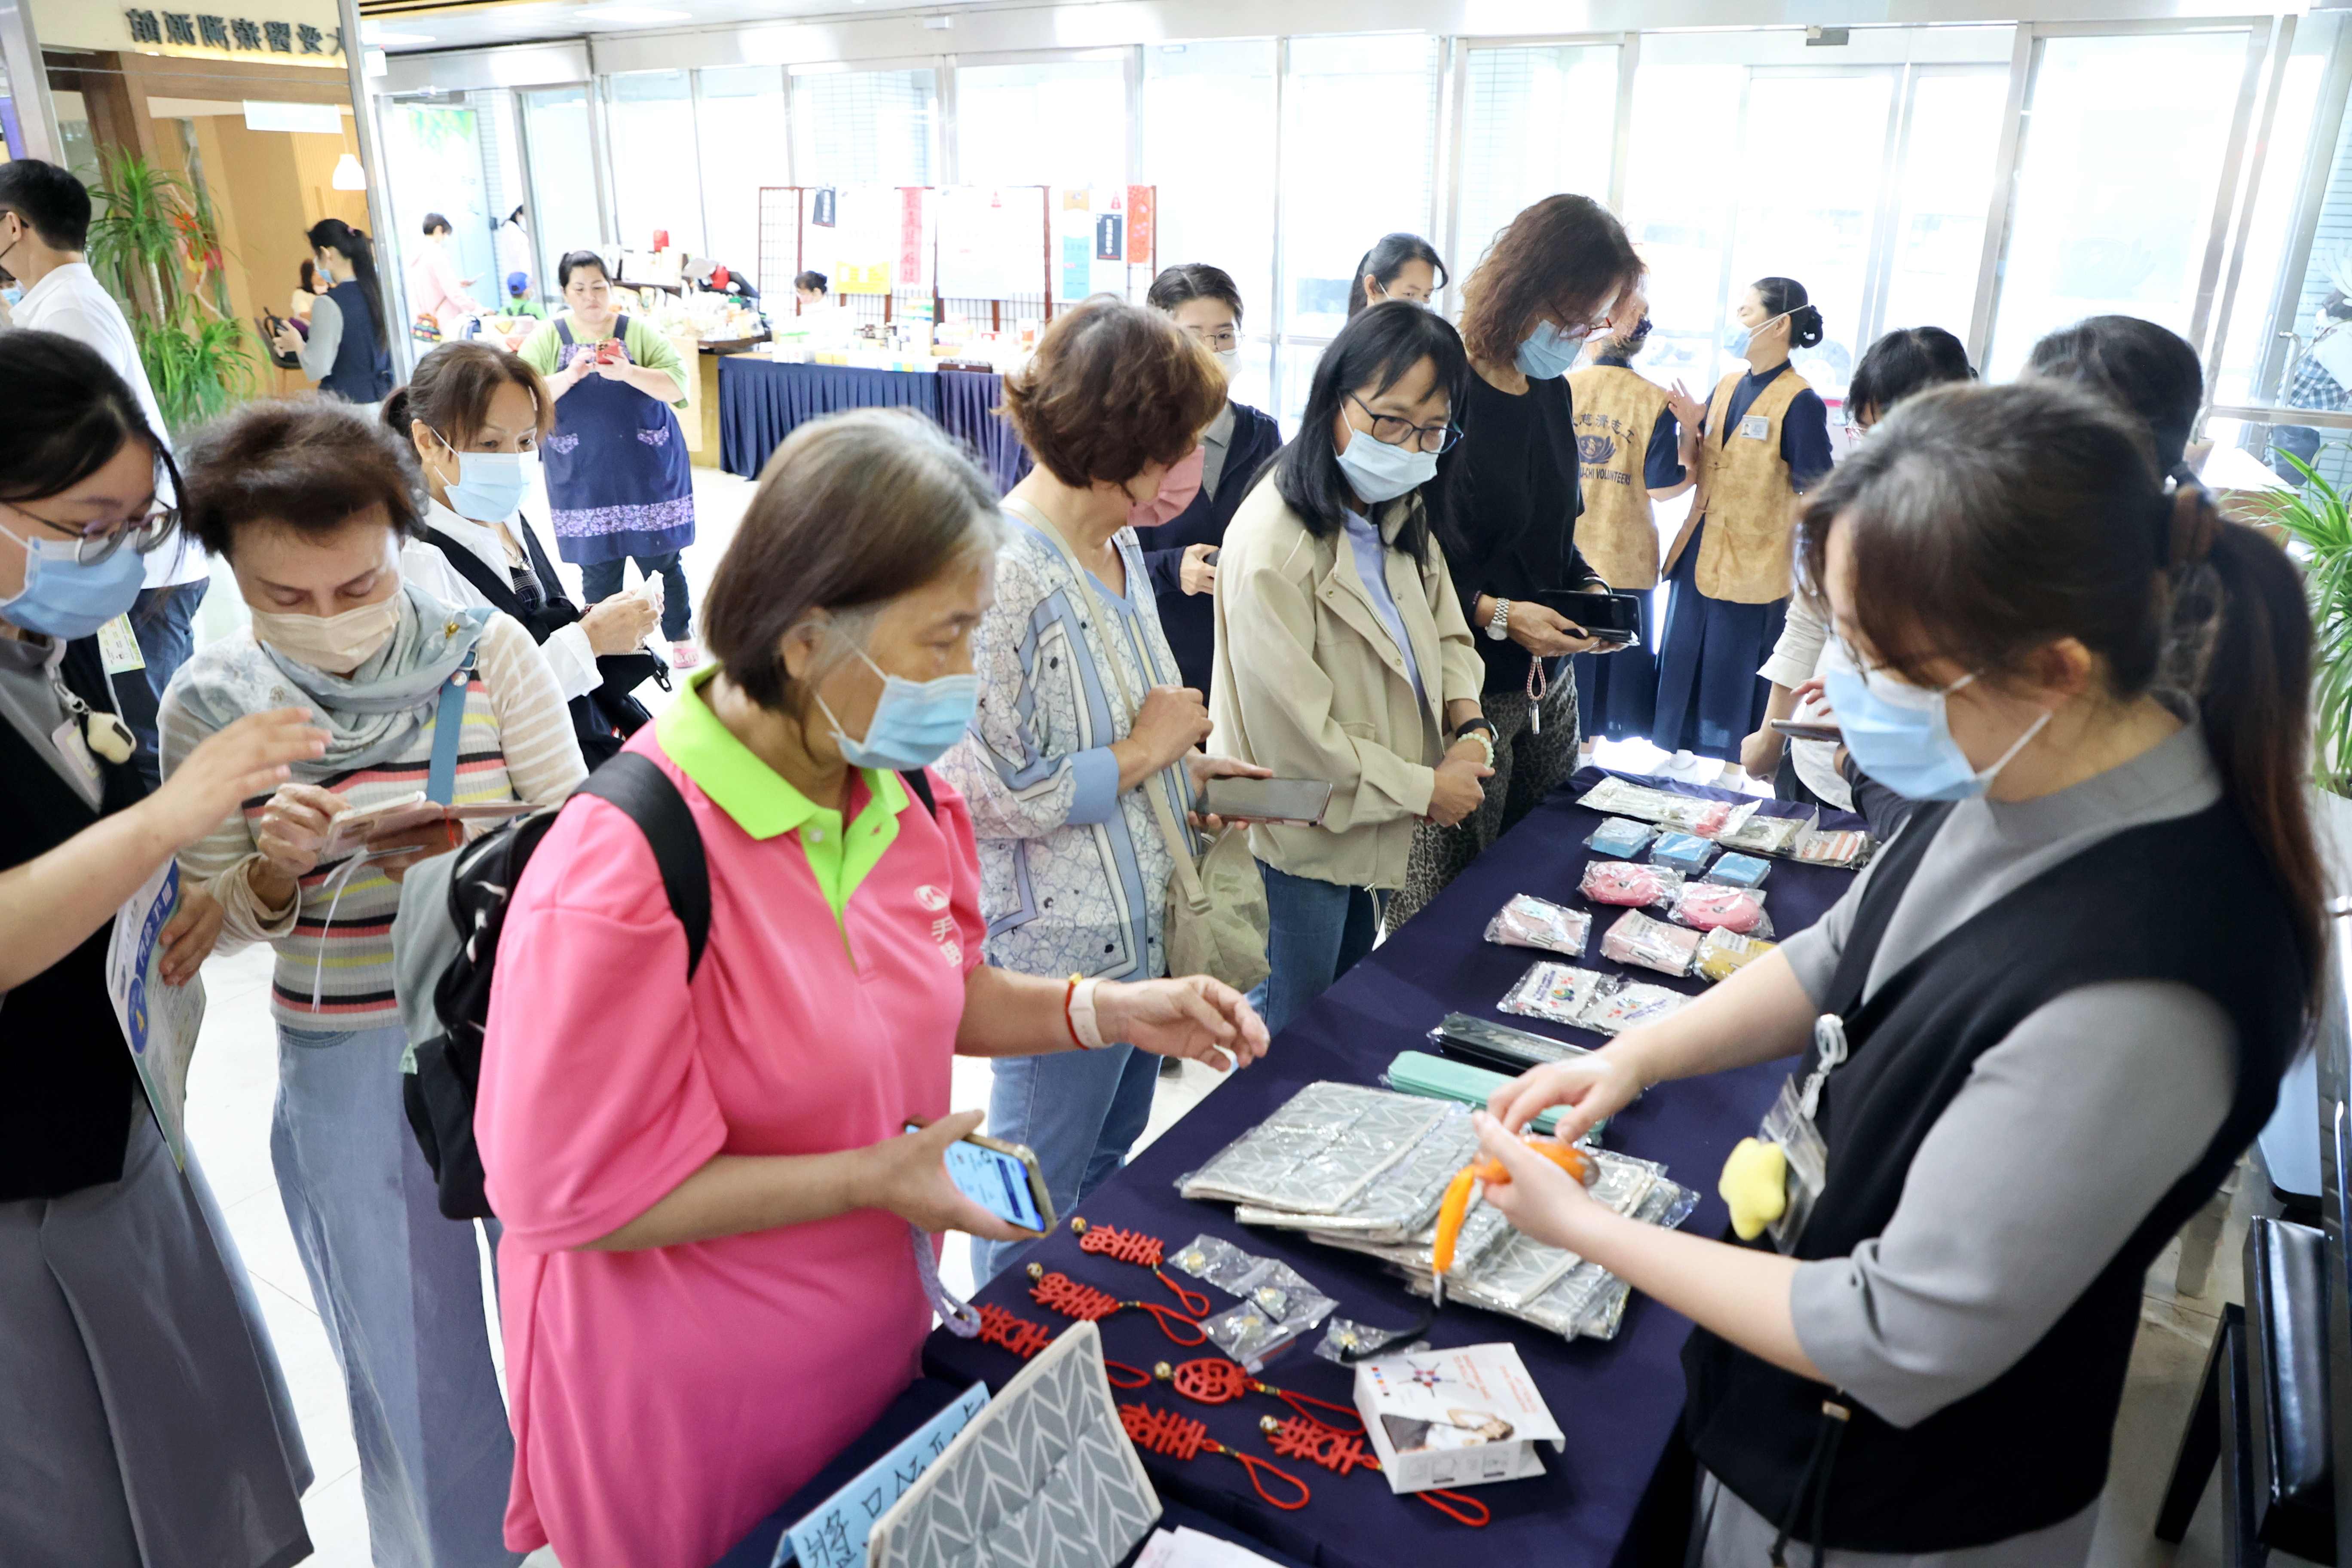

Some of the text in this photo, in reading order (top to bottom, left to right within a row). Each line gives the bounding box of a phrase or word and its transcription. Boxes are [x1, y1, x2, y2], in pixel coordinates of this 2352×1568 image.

[1571, 413, 1635, 444] 慈濟志工
[1596, 468, 1631, 486] VOLUNTEERS
